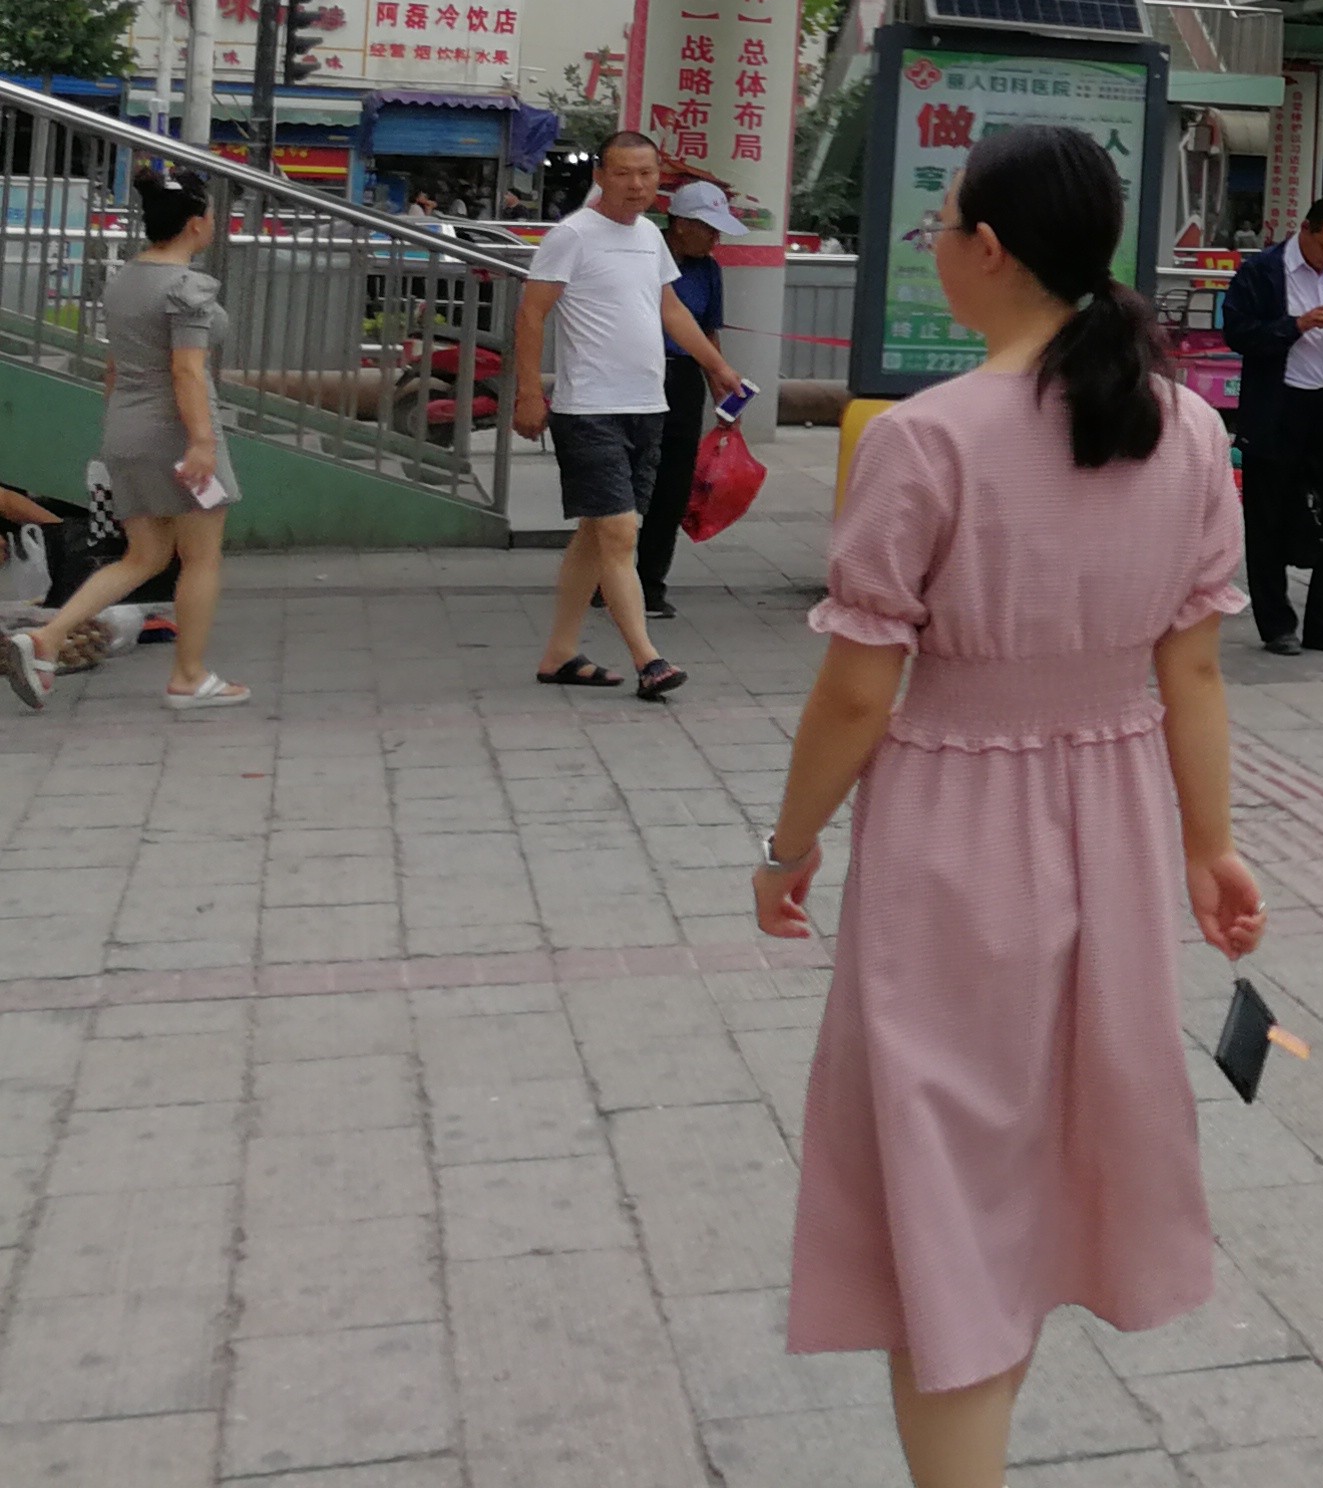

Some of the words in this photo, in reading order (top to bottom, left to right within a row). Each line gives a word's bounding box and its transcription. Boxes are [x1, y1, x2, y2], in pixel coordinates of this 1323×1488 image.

[376, 1, 517, 34] 阿磊冷饮店
